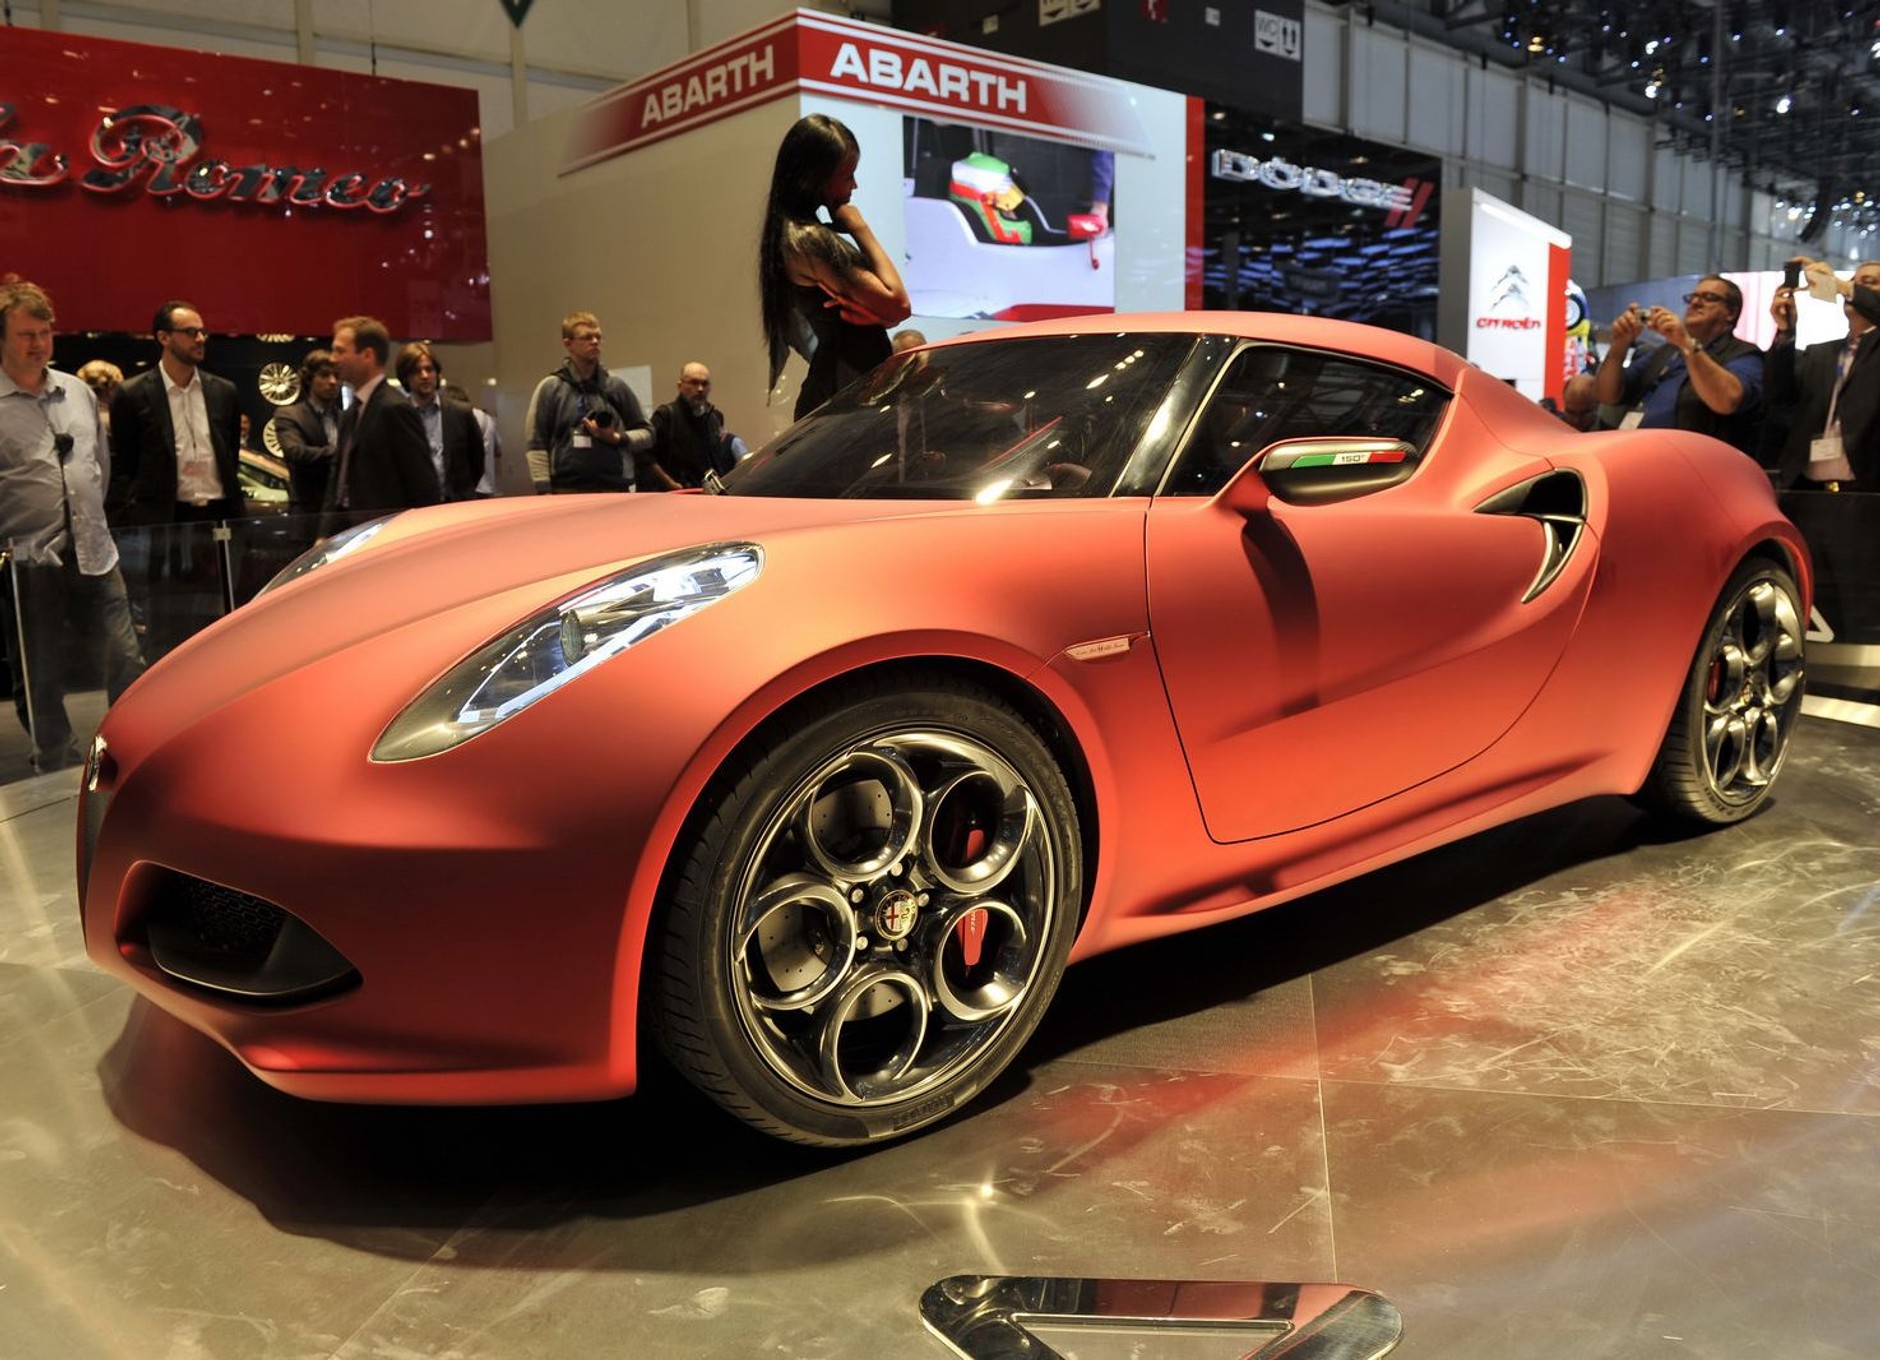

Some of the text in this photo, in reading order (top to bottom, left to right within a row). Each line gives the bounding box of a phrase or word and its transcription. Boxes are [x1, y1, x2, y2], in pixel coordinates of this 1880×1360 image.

[641, 44, 774, 129] ABARTH
[830, 42, 1027, 113] ABARTH
[81, 104, 430, 214] Romeo
[1212, 149, 1413, 212] DODGE
